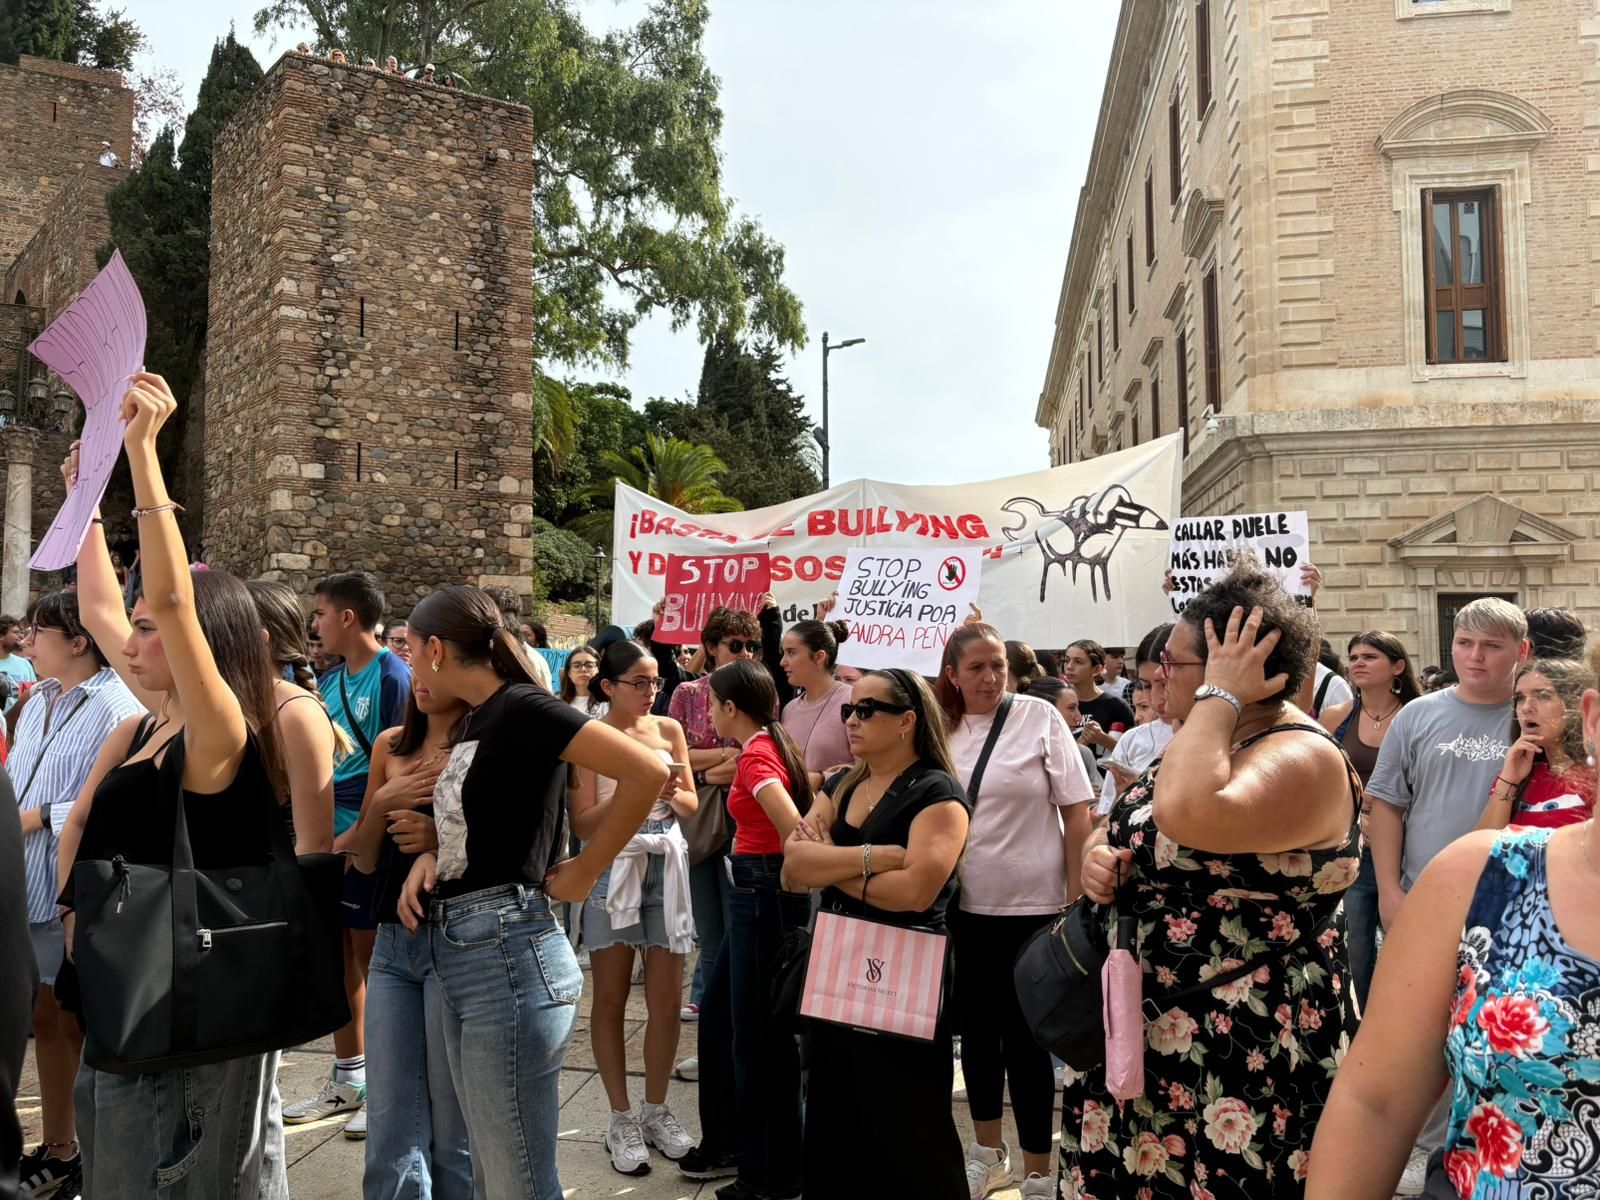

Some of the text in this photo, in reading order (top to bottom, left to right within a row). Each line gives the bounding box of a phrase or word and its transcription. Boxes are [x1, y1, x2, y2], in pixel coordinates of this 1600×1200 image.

[807, 506, 990, 540] BULLYING
[1174, 513, 1290, 541] CALLAR DUELE
[628, 551, 643, 575] Y
[857, 556, 922, 580] STOP
[1171, 548, 1201, 570] MÁS
[1265, 546, 1297, 568] NO
[679, 557, 760, 585] STOP
[850, 580, 932, 600] BULLYING
[844, 598, 956, 623] JUSTICIA POR
[912, 623, 949, 649] PEÑ
